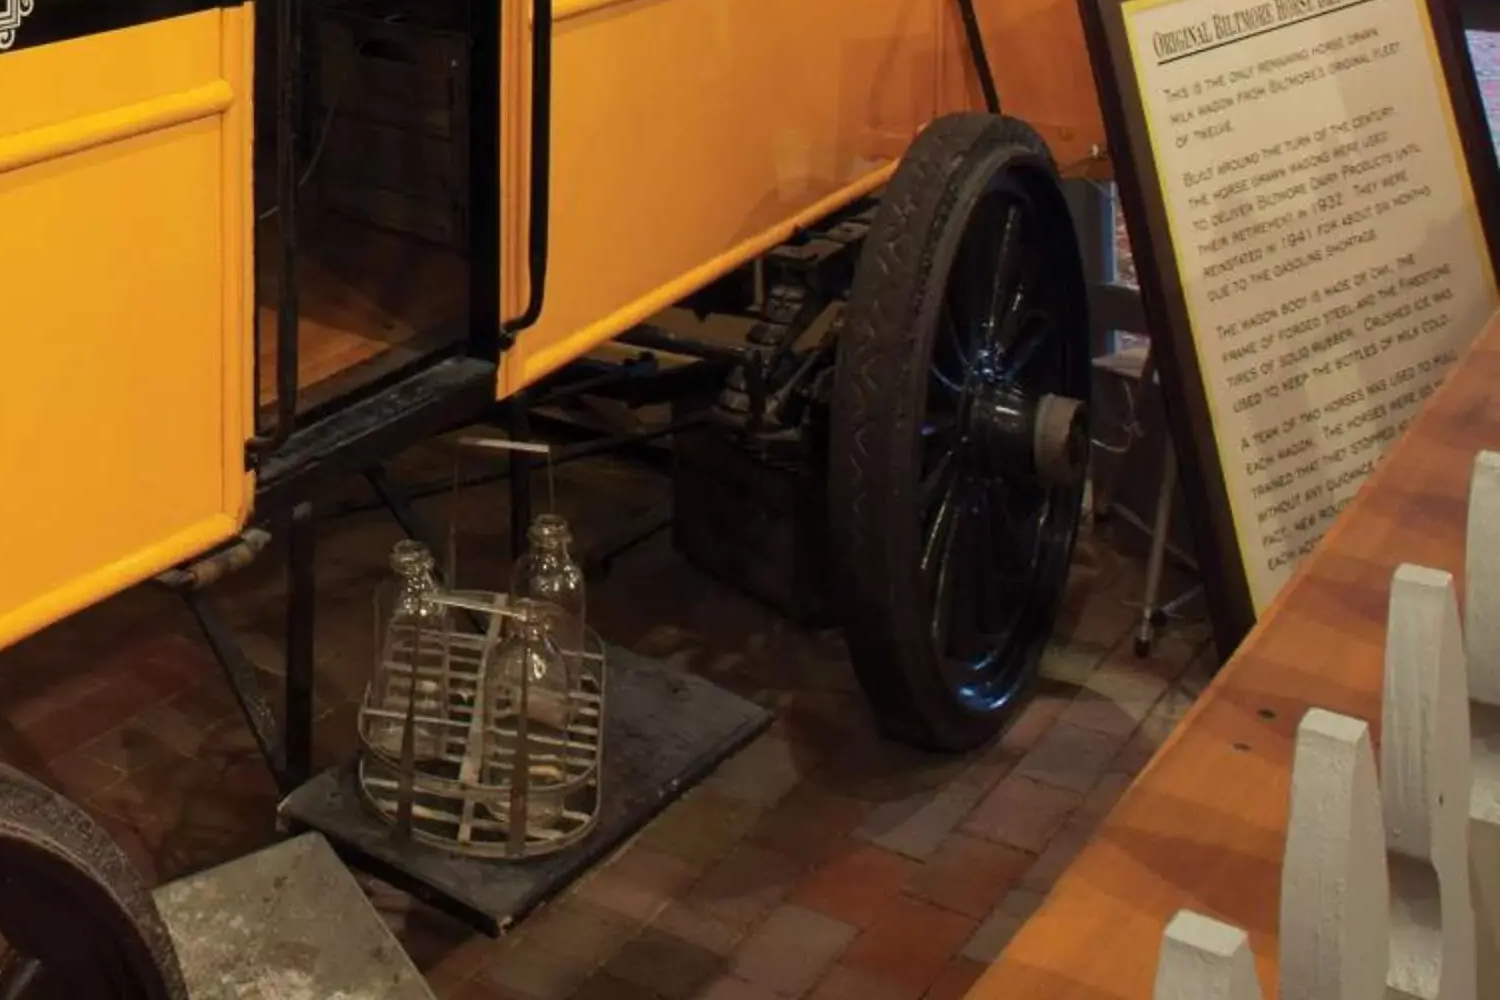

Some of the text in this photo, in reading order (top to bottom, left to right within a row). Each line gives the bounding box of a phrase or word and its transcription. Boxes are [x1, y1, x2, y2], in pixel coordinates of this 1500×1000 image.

[1212, 3, 1270, 39] BILTMORE
[1163, 27, 1378, 100] THIS IS THE ONLY REMAINING HORSE DRAWN
[1169, 111, 1194, 123] MILK
[1197, 97, 1233, 115] WAGON
[1236, 87, 1265, 101] FROM
[1329, 55, 1370, 74] ORIGINAL
[1373, 41, 1399, 57] FLEET
[1175, 134, 1188, 148] OF
[1182, 167, 1212, 187] BUILT
[1217, 152, 1259, 174] AROUND
[1260, 143, 1281, 156] THE
[1283, 135, 1311, 150] TURN
[1314, 127, 1326, 141] OF
[1329, 121, 1350, 133] THE
[1187, 193, 1209, 207] THE
[1212, 179, 1249, 199] HORSE
[1251, 168, 1286, 187] DRAWN
[1288, 150, 1330, 172] WAGONS
[1332, 141, 1358, 157] WERE
[1191, 218, 1207, 230] TO
[1211, 203, 1253, 226] DELIVER
[1256, 183, 1306, 209] BILTMORE
[1309, 172, 1337, 190] DAIRY
[1341, 152, 1392, 178] PRODUCTS
[1197, 235, 1228, 254] THEIR
[1231, 212, 1292, 242] RETIREMENT
[1297, 209, 1307, 219] IN
[1352, 182, 1377, 194] THEY
[1381, 169, 1408, 187] WERE
[1203, 248, 1262, 276] REINSTATED
[1265, 243, 1276, 253] IN
[1281, 229, 1311, 247] 1941
[1317, 220, 1337, 235] FOR
[1341, 206, 1371, 225] ABOUT
[1392, 185, 1430, 205] MONTHS
[1206, 283, 1230, 302] DUE
[1231, 278, 1247, 291] TO
[1249, 269, 1271, 281] THE
[1273, 249, 1322, 277] GASOLINE
[1215, 323, 1236, 338] THE
[1241, 309, 1278, 329] WAGON
[1280, 296, 1307, 315] BODY
[1311, 289, 1320, 302] IS
[1323, 278, 1351, 296] MADE
[1353, 271, 1366, 286] OF
[1396, 253, 1415, 266] THE
[1221, 341, 1257, 363] FRAME
[1260, 333, 1273, 349] OF
[1277, 316, 1320, 339] FORGED
[1356, 293, 1375, 309] AND
[1377, 284, 1396, 297] THE
[1398, 263, 1451, 288] FIRESTONE
[1225, 366, 1258, 387] TIRES
[1259, 359, 1274, 375] OF
[1279, 345, 1309, 368] SOLID
[1363, 304, 1411, 332] CRUSHED
[1413, 295, 1431, 311] ICE
[1431, 287, 1453, 302] WAS
[1232, 392, 1261, 413] USED
[1263, 385, 1278, 397] TO
[1281, 372, 1309, 391] KEEP
[1311, 361, 1332, 374] THE
[1334, 342, 1377, 369] BOTTLES
[1379, 335, 1392, 350] OF
[1396, 326, 1419, 343] MILK
[1241, 437, 1250, 451] A
[1252, 427, 1278, 444] TEAM
[1282, 417, 1295, 433] OF
[1299, 408, 1320, 423] TWO
[1323, 388, 1364, 412] HORSES
[1365, 379, 1386, 395] WAS
[1389, 367, 1415, 386] USED
[1417, 360, 1430, 372] TO
[1245, 455, 1275, 475] EACH
[1322, 422, 1343, 438] THE
[1346, 404, 1386, 428] HORSES
[1250, 471, 1293, 498] TRAINED
[1295, 459, 1318, 477] THAT
[1321, 447, 1346, 462] THEY
[1349, 425, 1395, 454] STOPPED
[1257, 460, 1374, 523] WITHOUT ANY GUIDANCE
